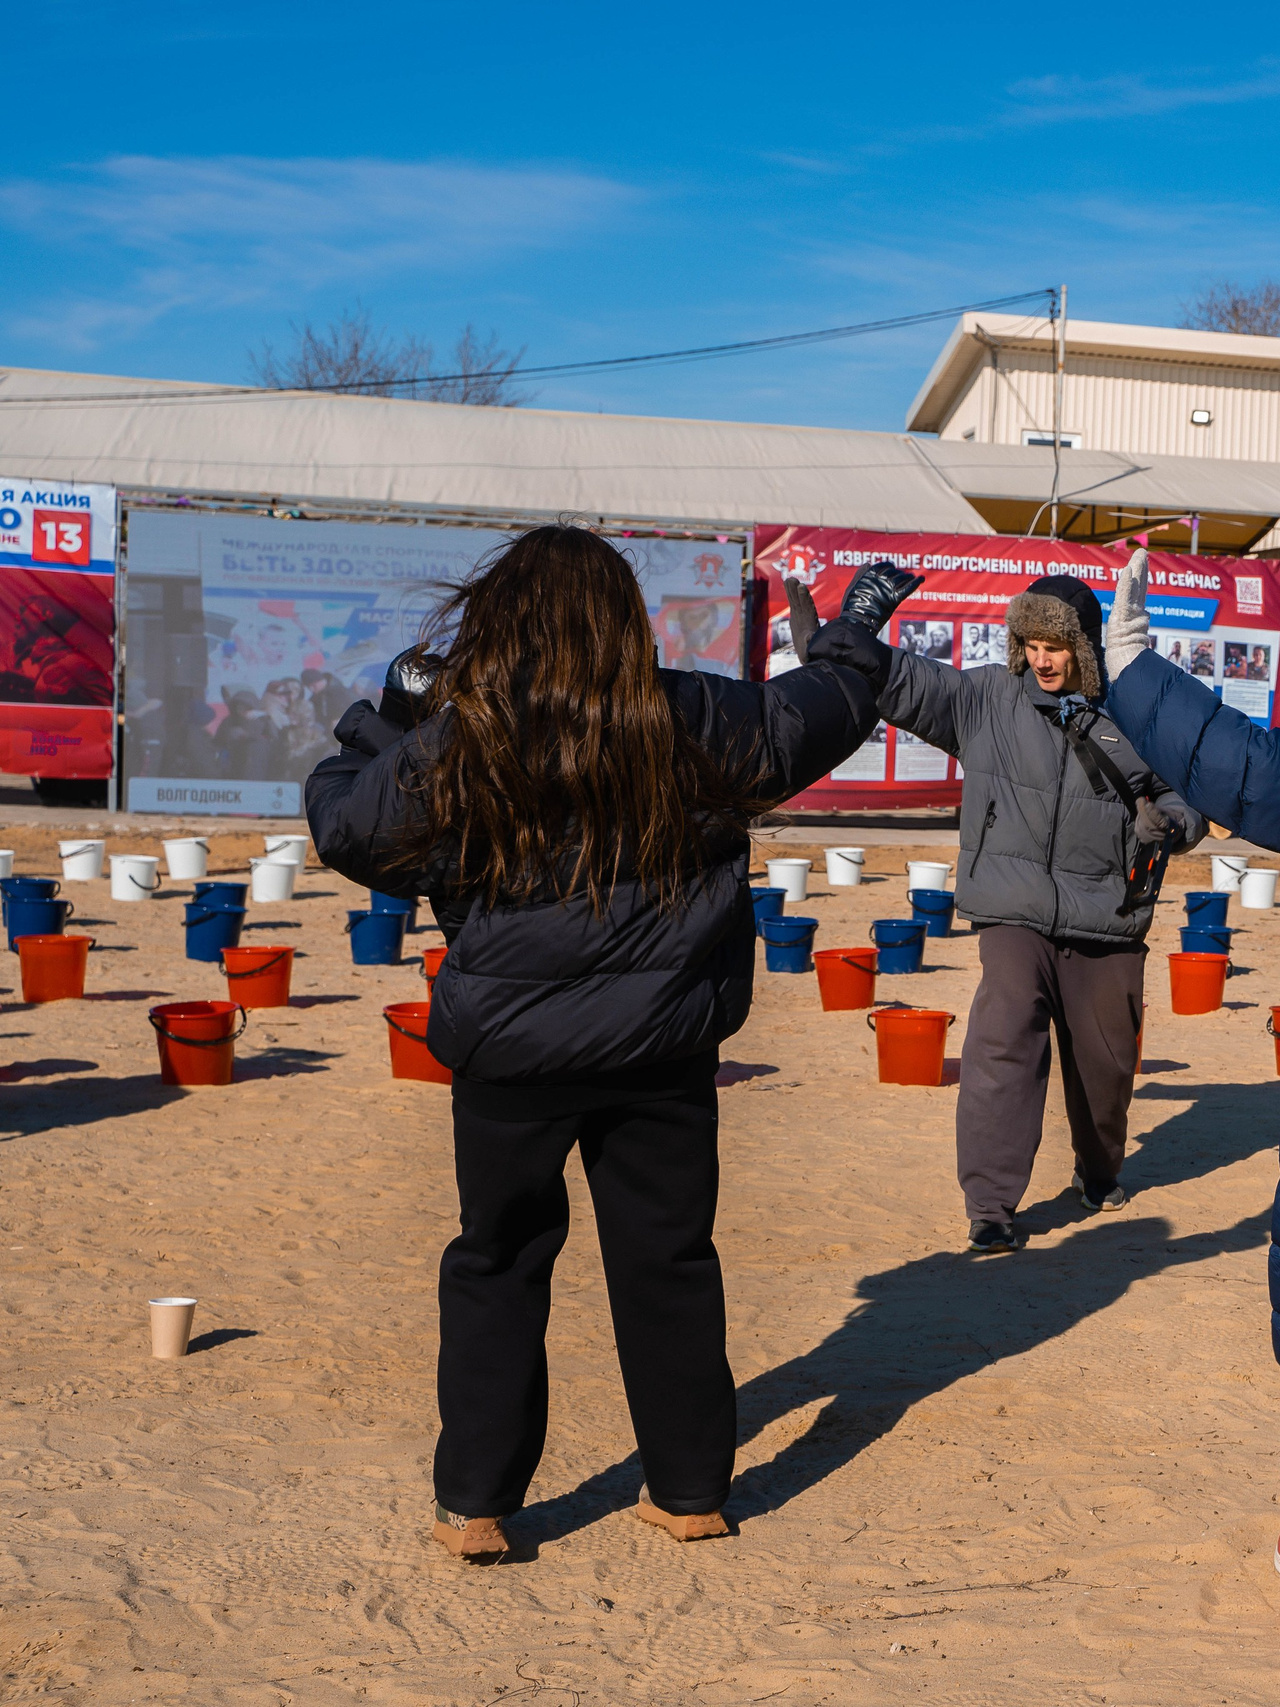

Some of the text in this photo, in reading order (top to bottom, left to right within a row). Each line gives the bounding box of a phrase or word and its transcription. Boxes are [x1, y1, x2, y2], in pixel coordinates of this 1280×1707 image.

[21, 491, 91, 509] АКЦИЯ
[40, 521, 83, 553] 13
[833, 550, 920, 570] ИЗВЕСТНЫЕ
[923, 555, 1022, 574] СПОРТСМЕНЫ
[1026, 560, 1045, 576] НА
[1047, 561, 1108, 581] ФРОНТЕ.
[1156, 571, 1167, 585] И
[1169, 570, 1222, 589] СЕЙЧАС
[922, 590, 988, 604] ОТЕЧЕСТВЕННОЙ
[989, 594, 1012, 604] ВОЙН
[1165, 607, 1205, 618] ОПЕРАЦИИ
[157, 788, 241, 804] ВОЛГОДОНСК
